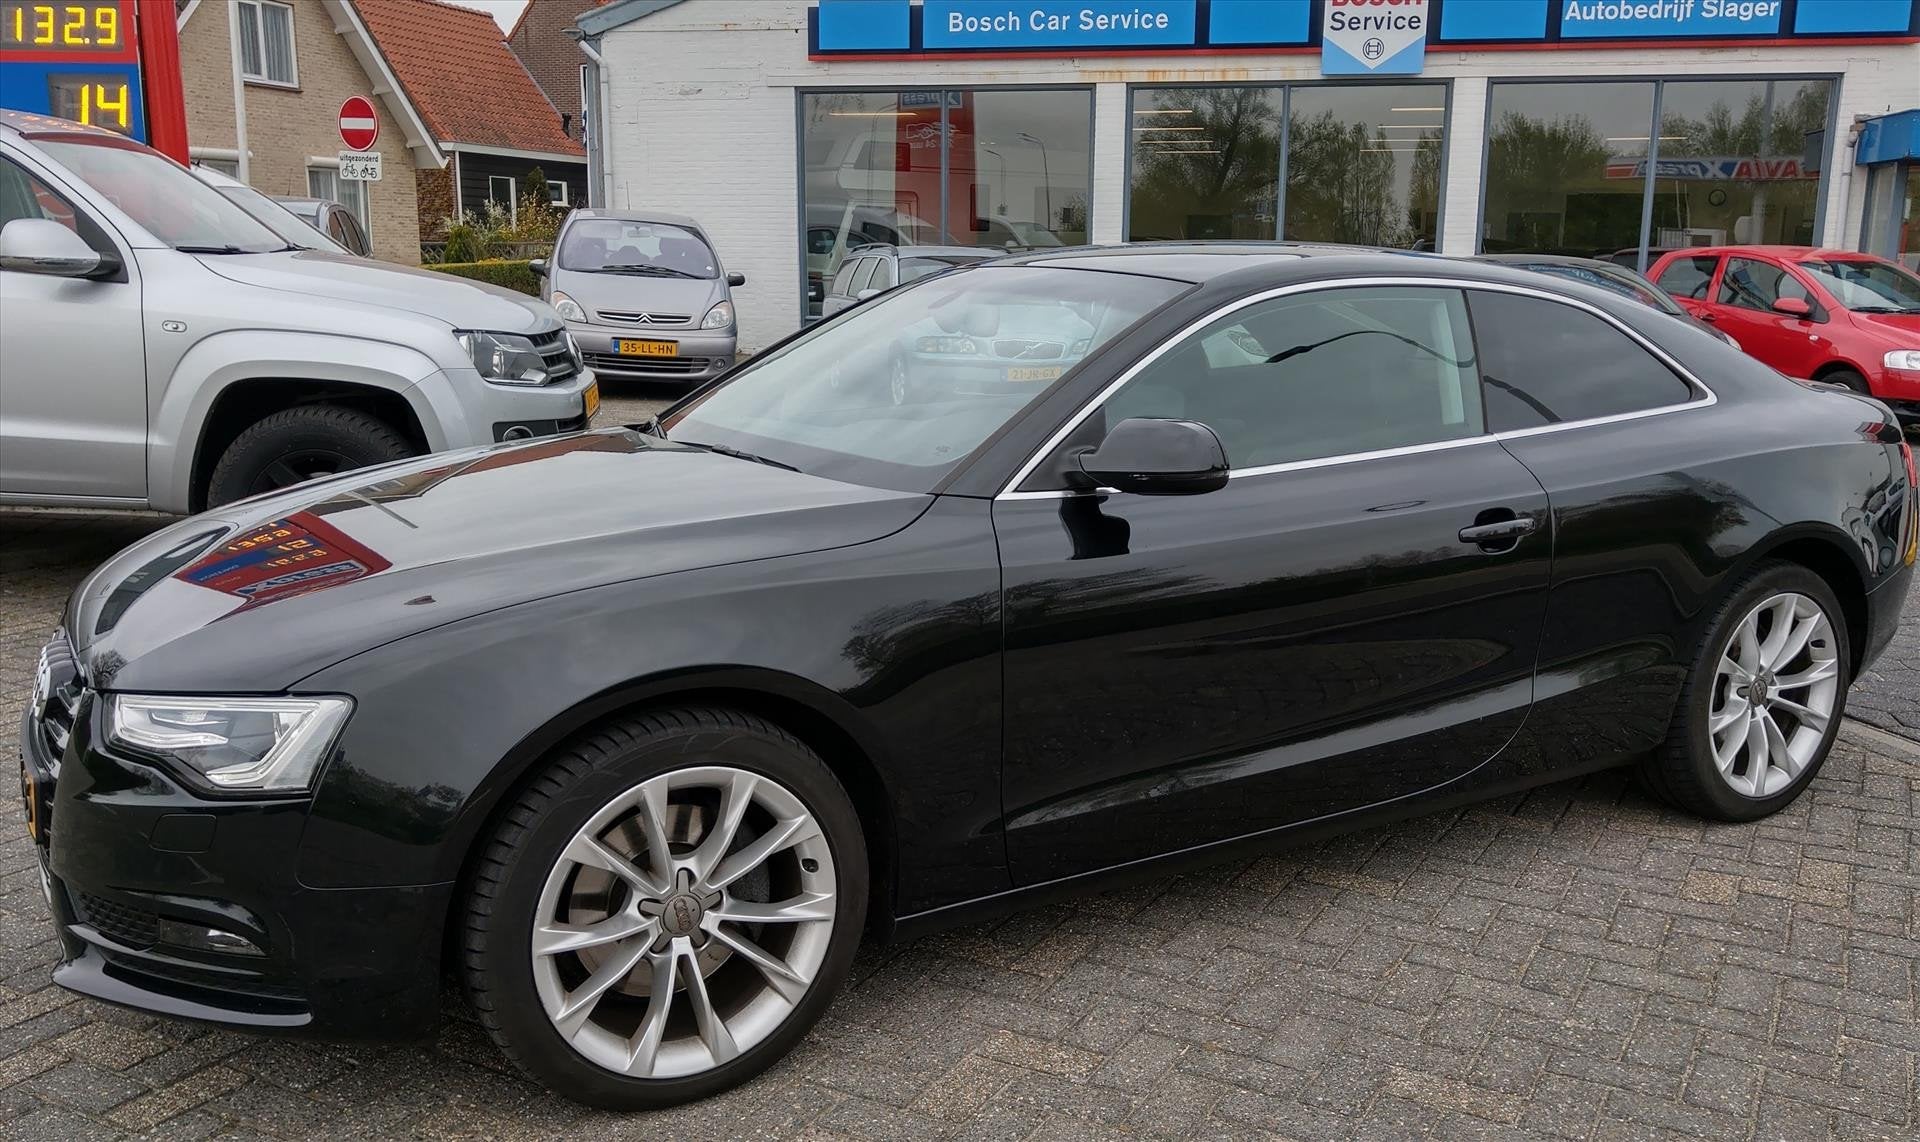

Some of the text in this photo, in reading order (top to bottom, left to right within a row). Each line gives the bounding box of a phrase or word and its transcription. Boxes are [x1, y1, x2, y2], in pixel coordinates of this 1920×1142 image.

[948, 8, 1169, 32] Bosch Car Service
[1329, 10, 1422, 31] Service
[1564, 0, 1780, 22] Autobedrijf Slager
[15, 6, 117, 44] 132.9
[81, 84, 128, 128] 14
[340, 154, 379, 163] uitgezonderd
[623, 342, 673, 355] 35-LL-HN
